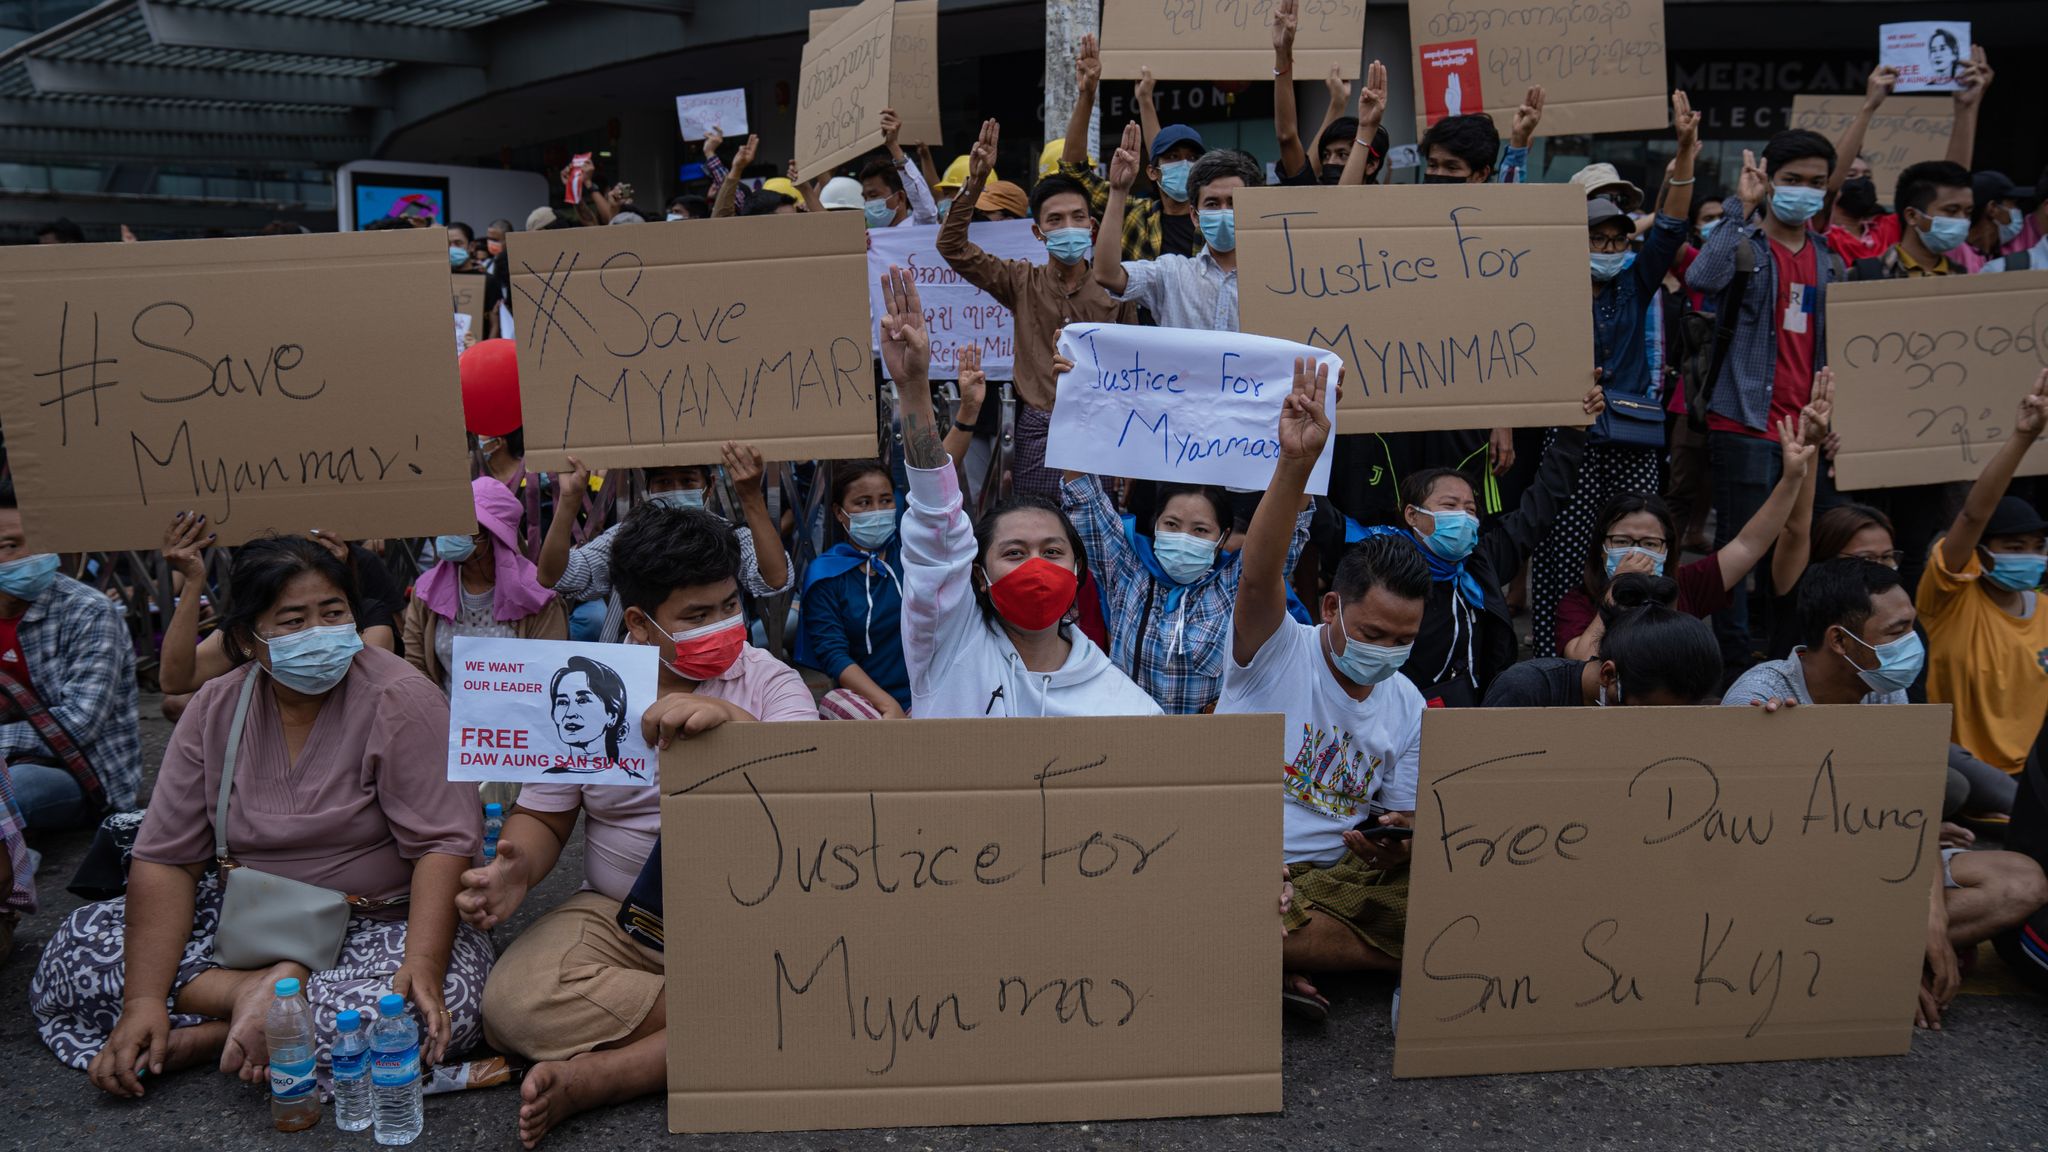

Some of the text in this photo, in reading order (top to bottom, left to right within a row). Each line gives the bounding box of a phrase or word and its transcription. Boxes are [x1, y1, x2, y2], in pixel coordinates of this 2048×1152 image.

[1675, 60, 1874, 91] MERICAN
[1260, 207, 1532, 298] Justice For
[512, 251, 746, 370] #Save
[34, 301, 326, 446] #Save
[1078, 328, 1264, 397] Justice For
[1306, 322, 1539, 398] MYANMAR
[1117, 408, 1282, 468] Myanmar
[463, 680, 543, 693] OUR LEADER
[465, 661, 525, 674] WE WANT
[460, 753, 645, 771] DAW AUNG SAN SU KYI
[461, 728, 529, 749] FREE
[670, 746, 1179, 907] Justice For
[1432, 749, 1928, 883] Free Daw Aung
[1422, 911, 1835, 1038] San Su Kyi
